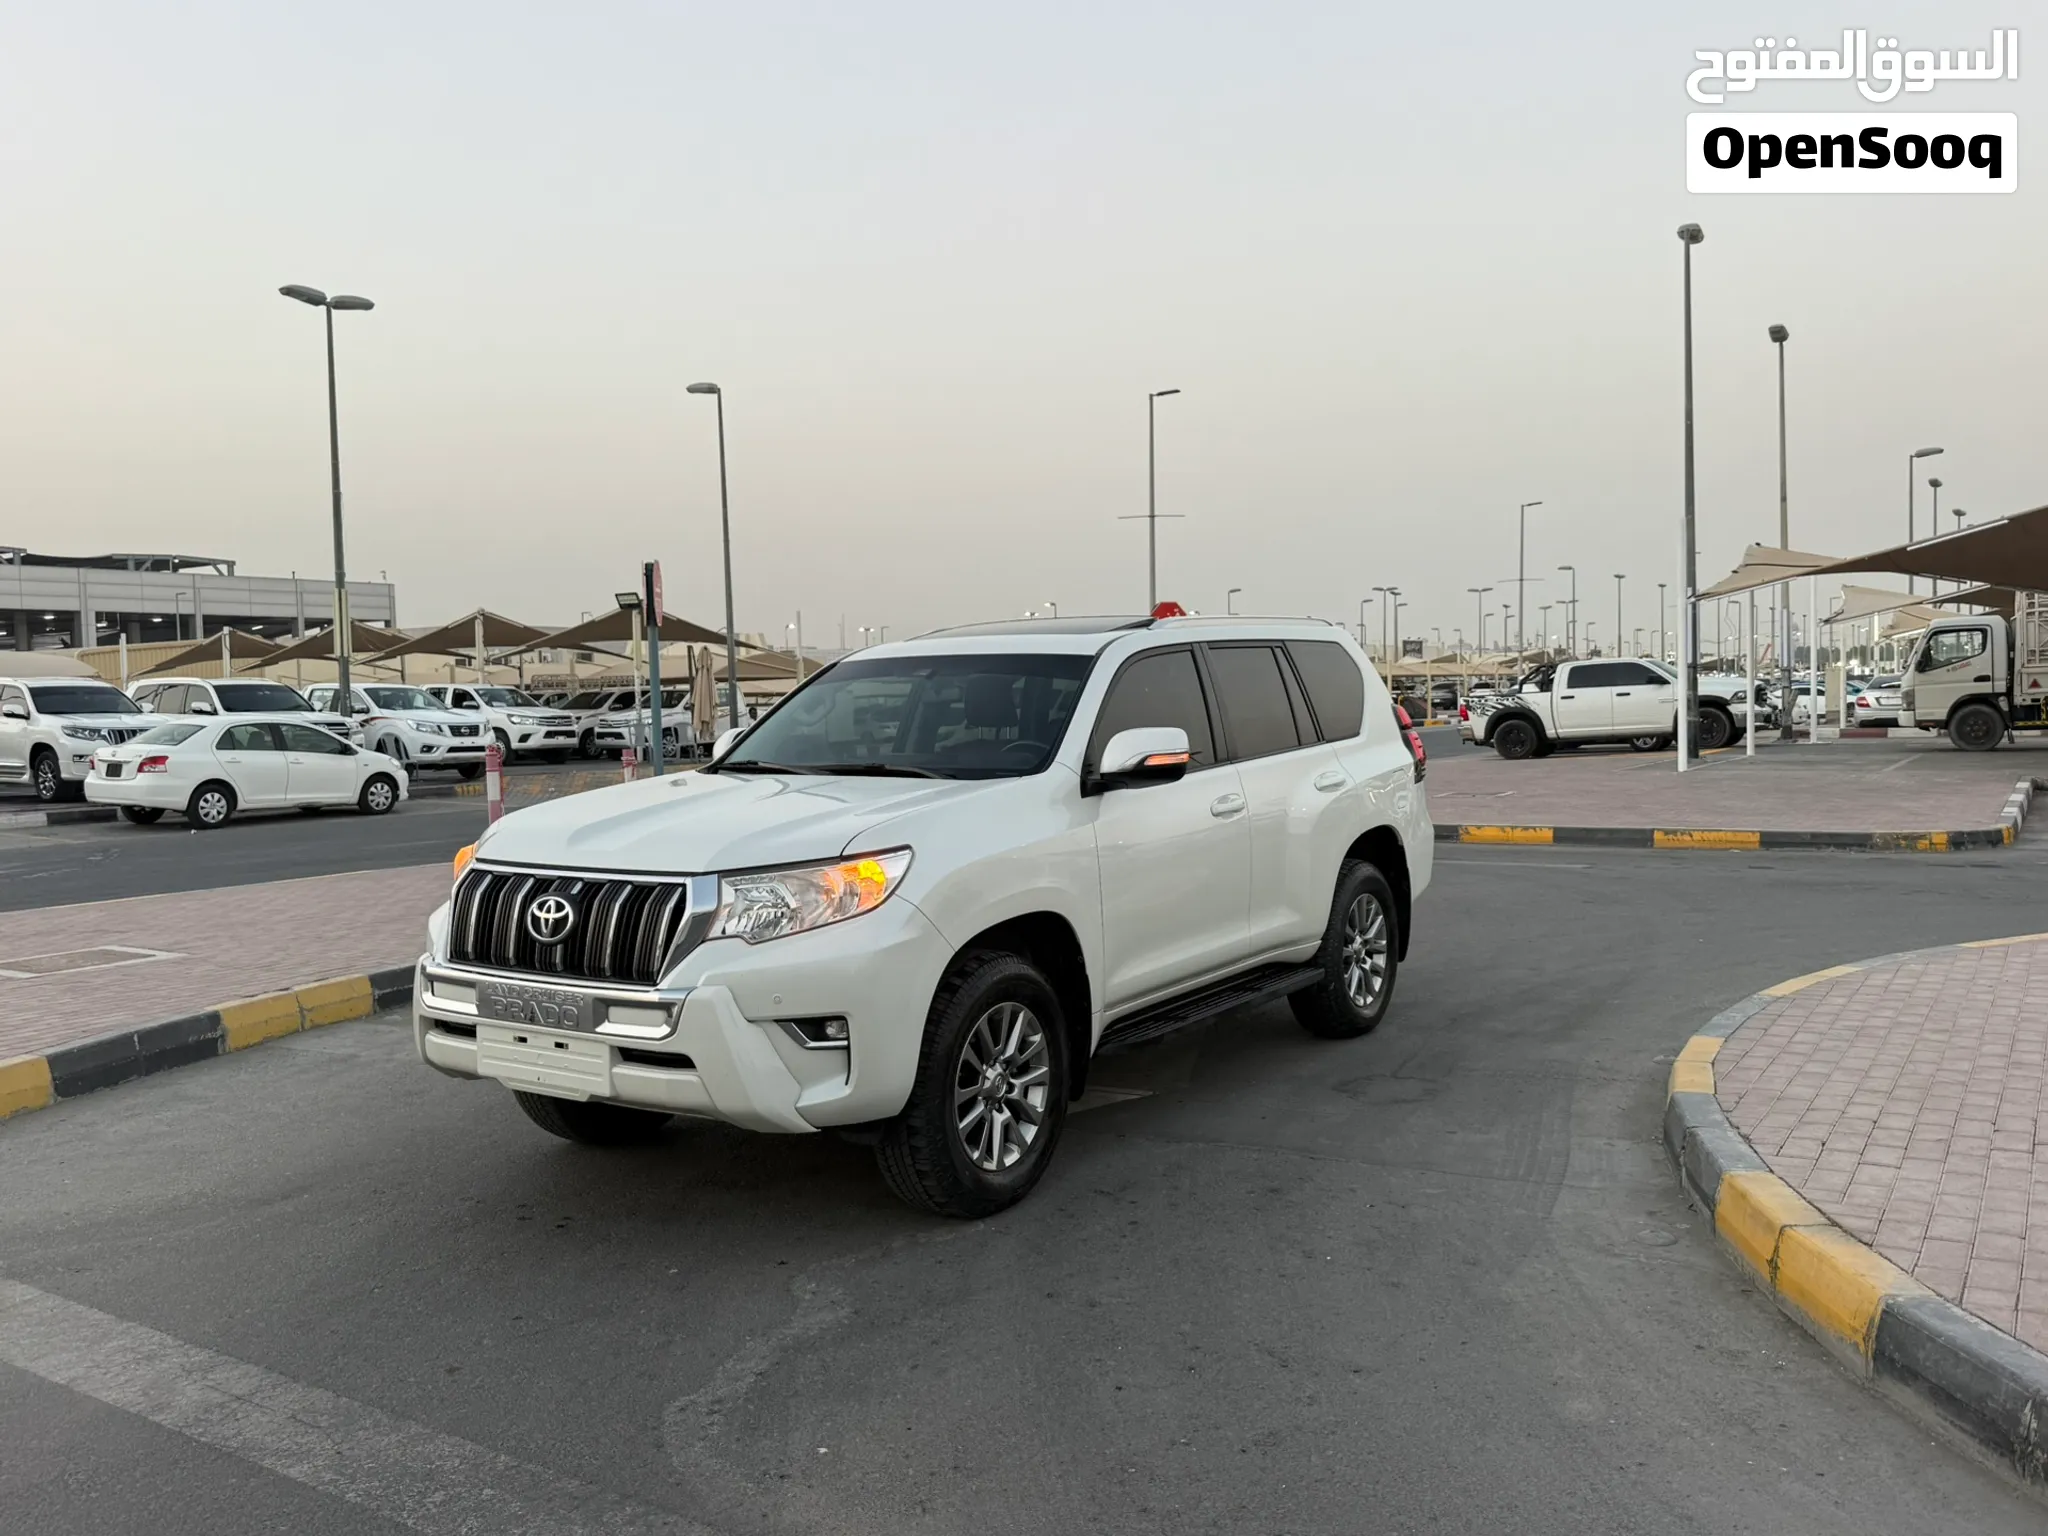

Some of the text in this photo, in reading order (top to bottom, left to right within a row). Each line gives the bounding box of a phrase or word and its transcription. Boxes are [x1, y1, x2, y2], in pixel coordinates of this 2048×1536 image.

[485, 982, 584, 1006] LAND CRUISER
[490, 996, 579, 1028] PRADO
